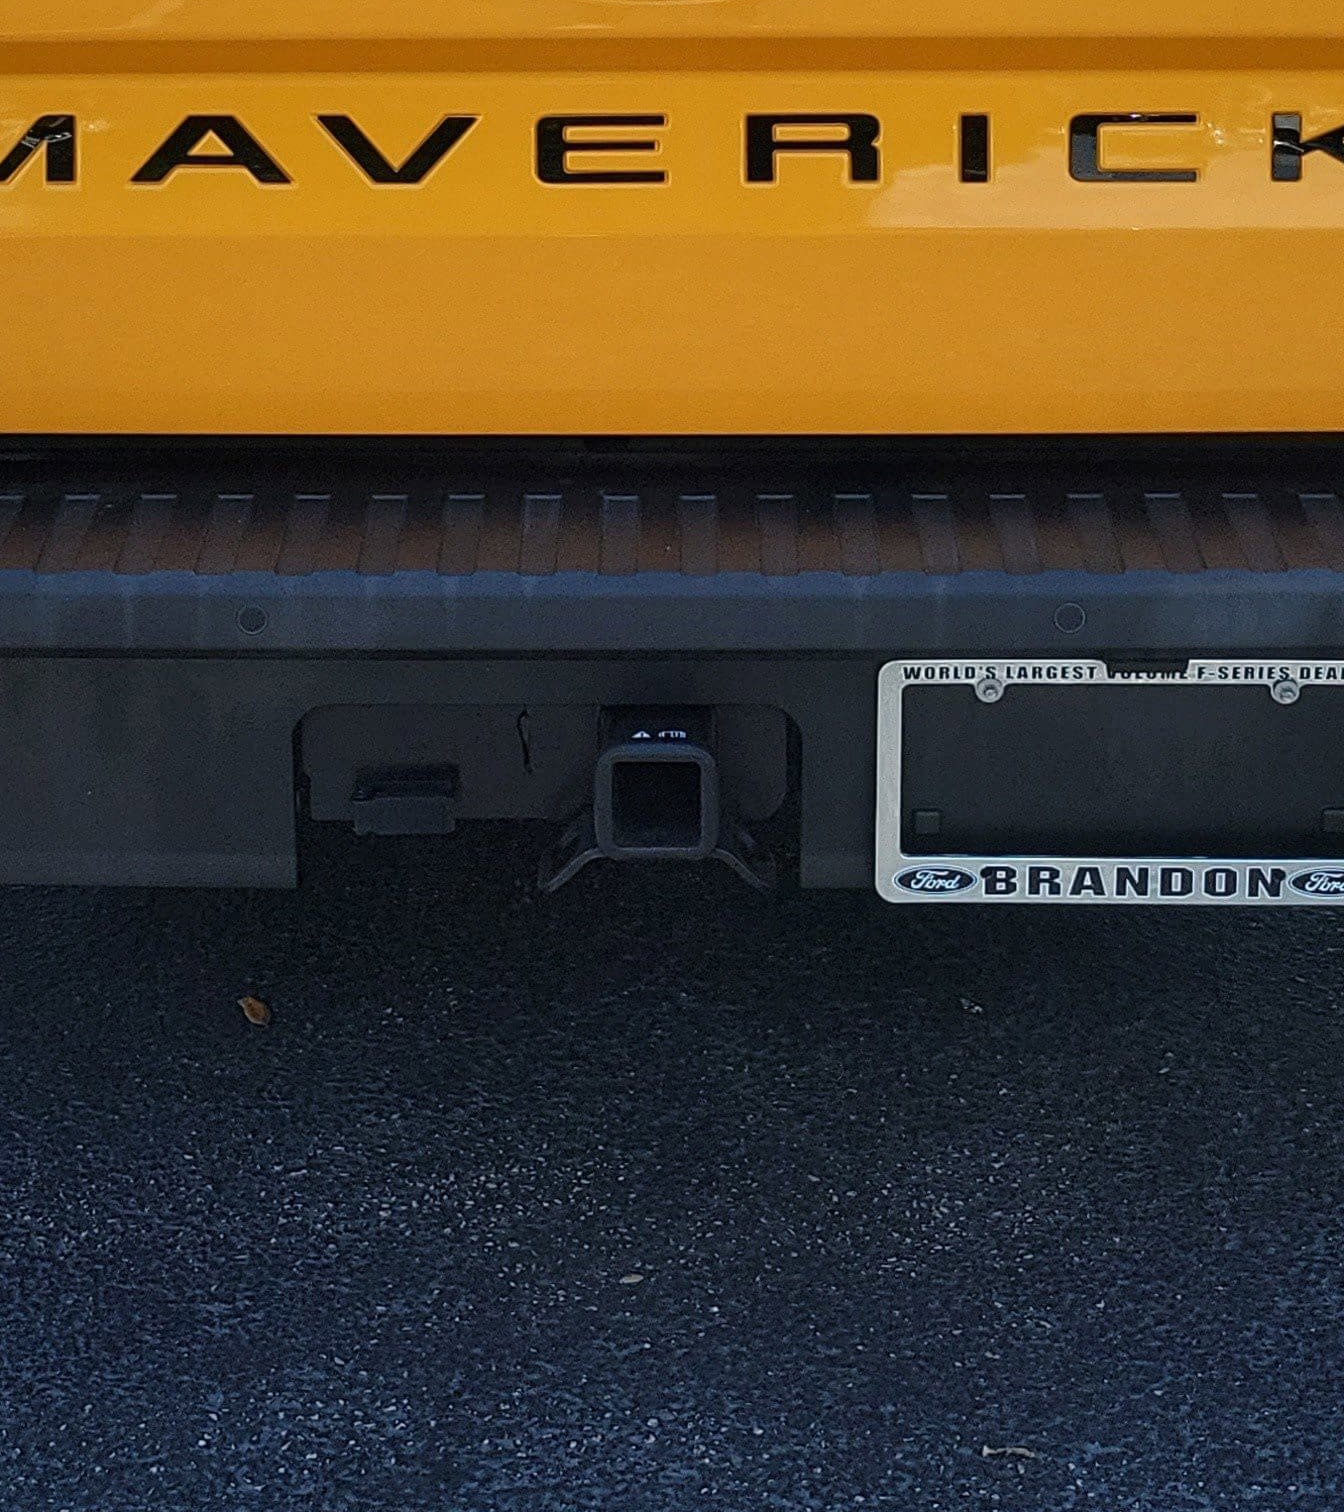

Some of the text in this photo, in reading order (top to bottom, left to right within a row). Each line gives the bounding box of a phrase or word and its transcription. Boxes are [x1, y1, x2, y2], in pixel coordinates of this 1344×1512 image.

[903, 666, 997, 680] WORLD'S
[1006, 666, 1098, 680] LARGEST
[1197, 666, 1290, 681] F-SERIES
[910, 870, 961, 890] Ford
[980, 866, 1287, 898] BRANDON
